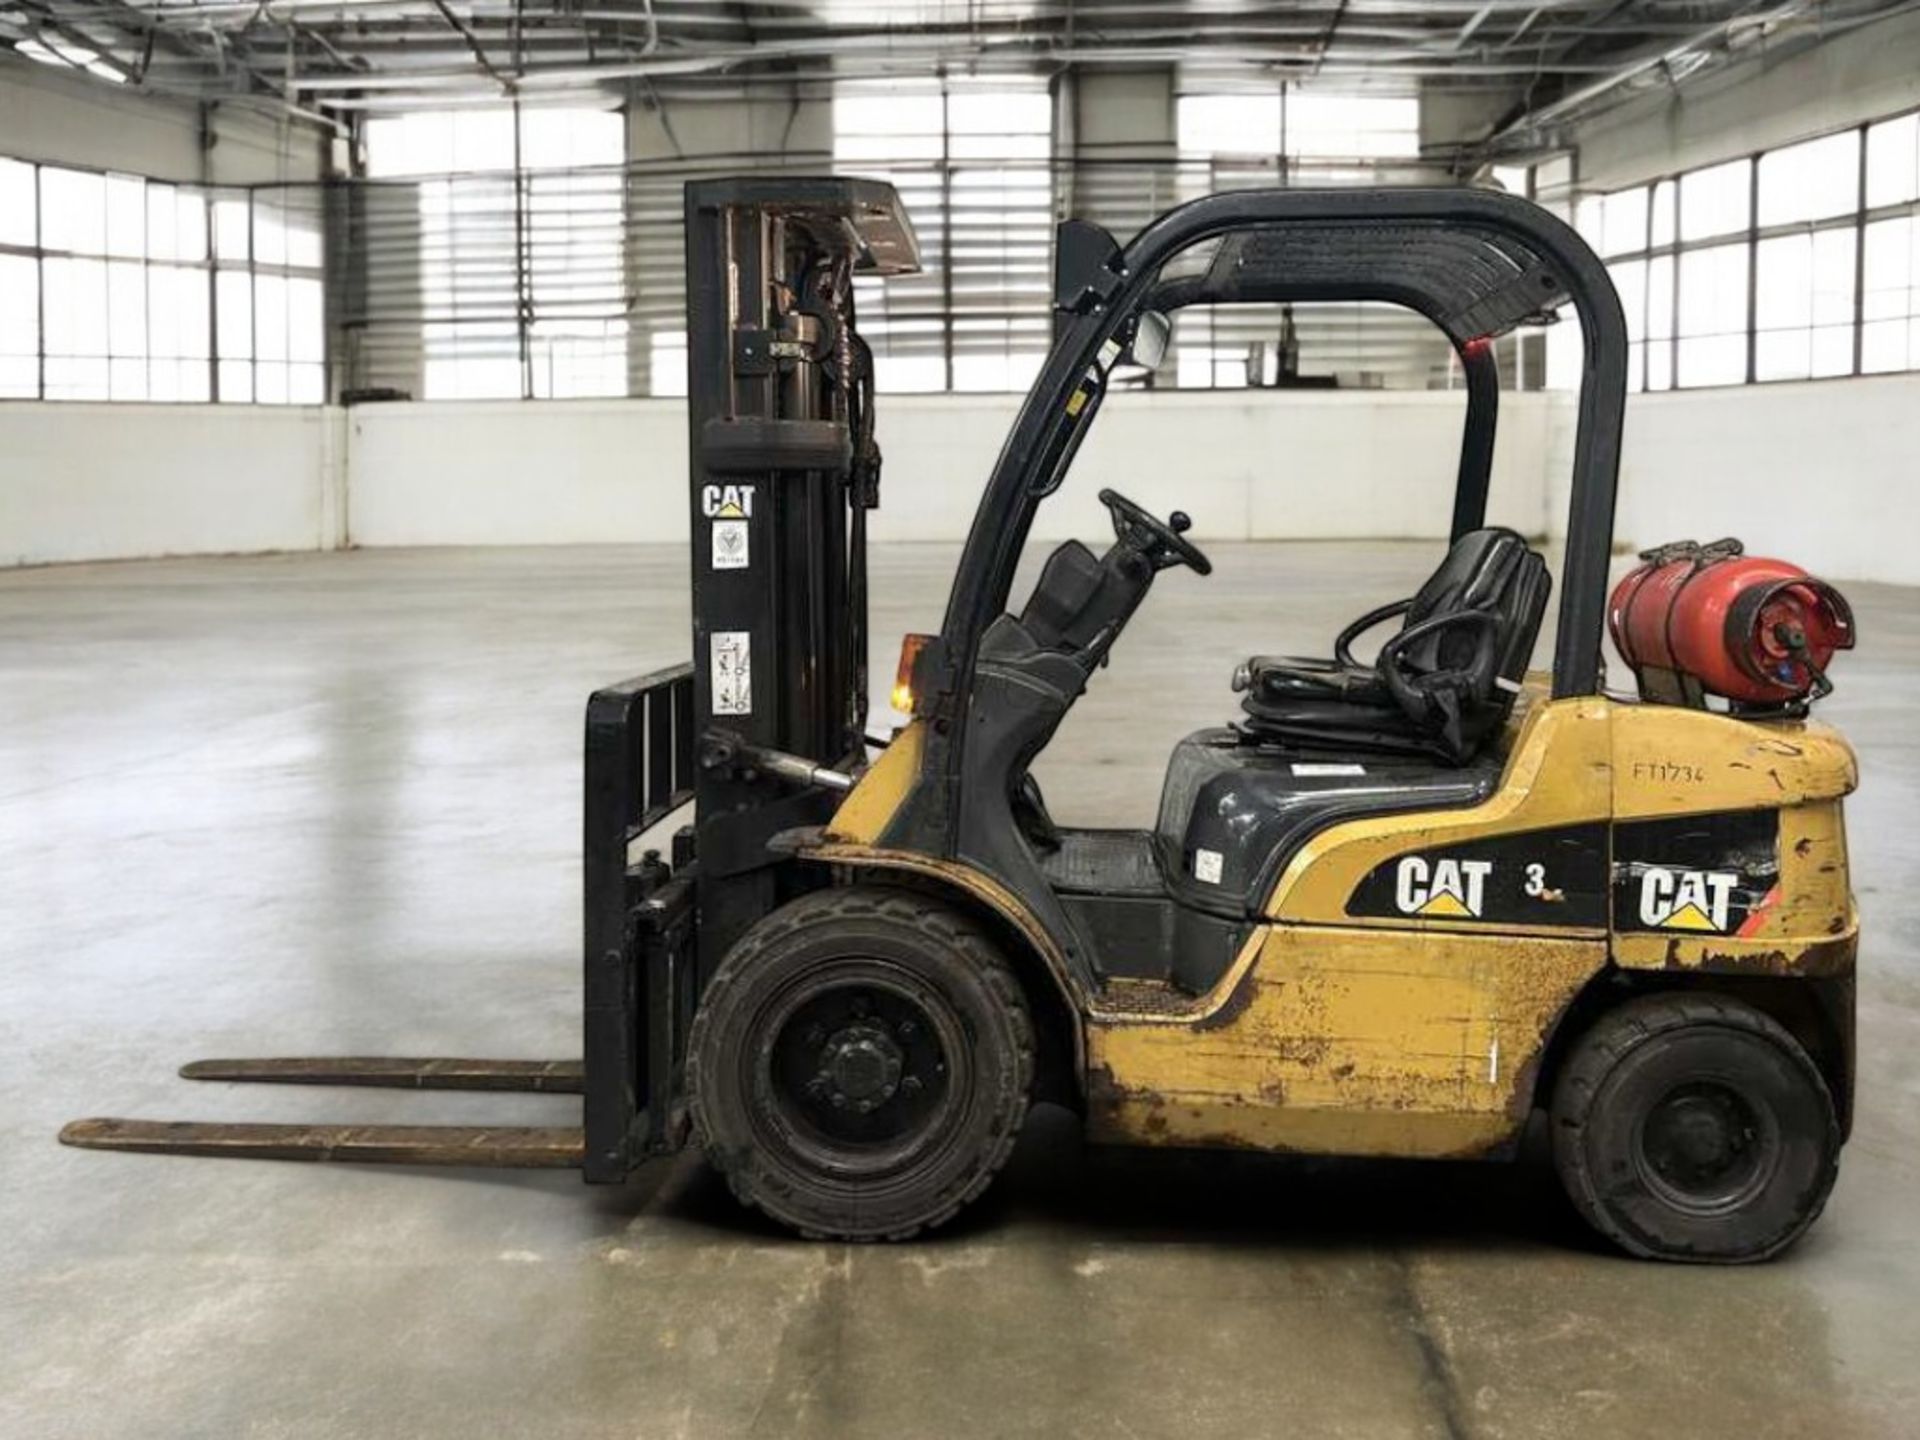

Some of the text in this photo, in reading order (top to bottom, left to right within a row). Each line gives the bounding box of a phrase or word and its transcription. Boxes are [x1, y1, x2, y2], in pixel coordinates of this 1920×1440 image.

[703, 485, 755, 517] CAT
[1396, 856, 1492, 917] CAT
[1640, 867, 1738, 931] CAT
